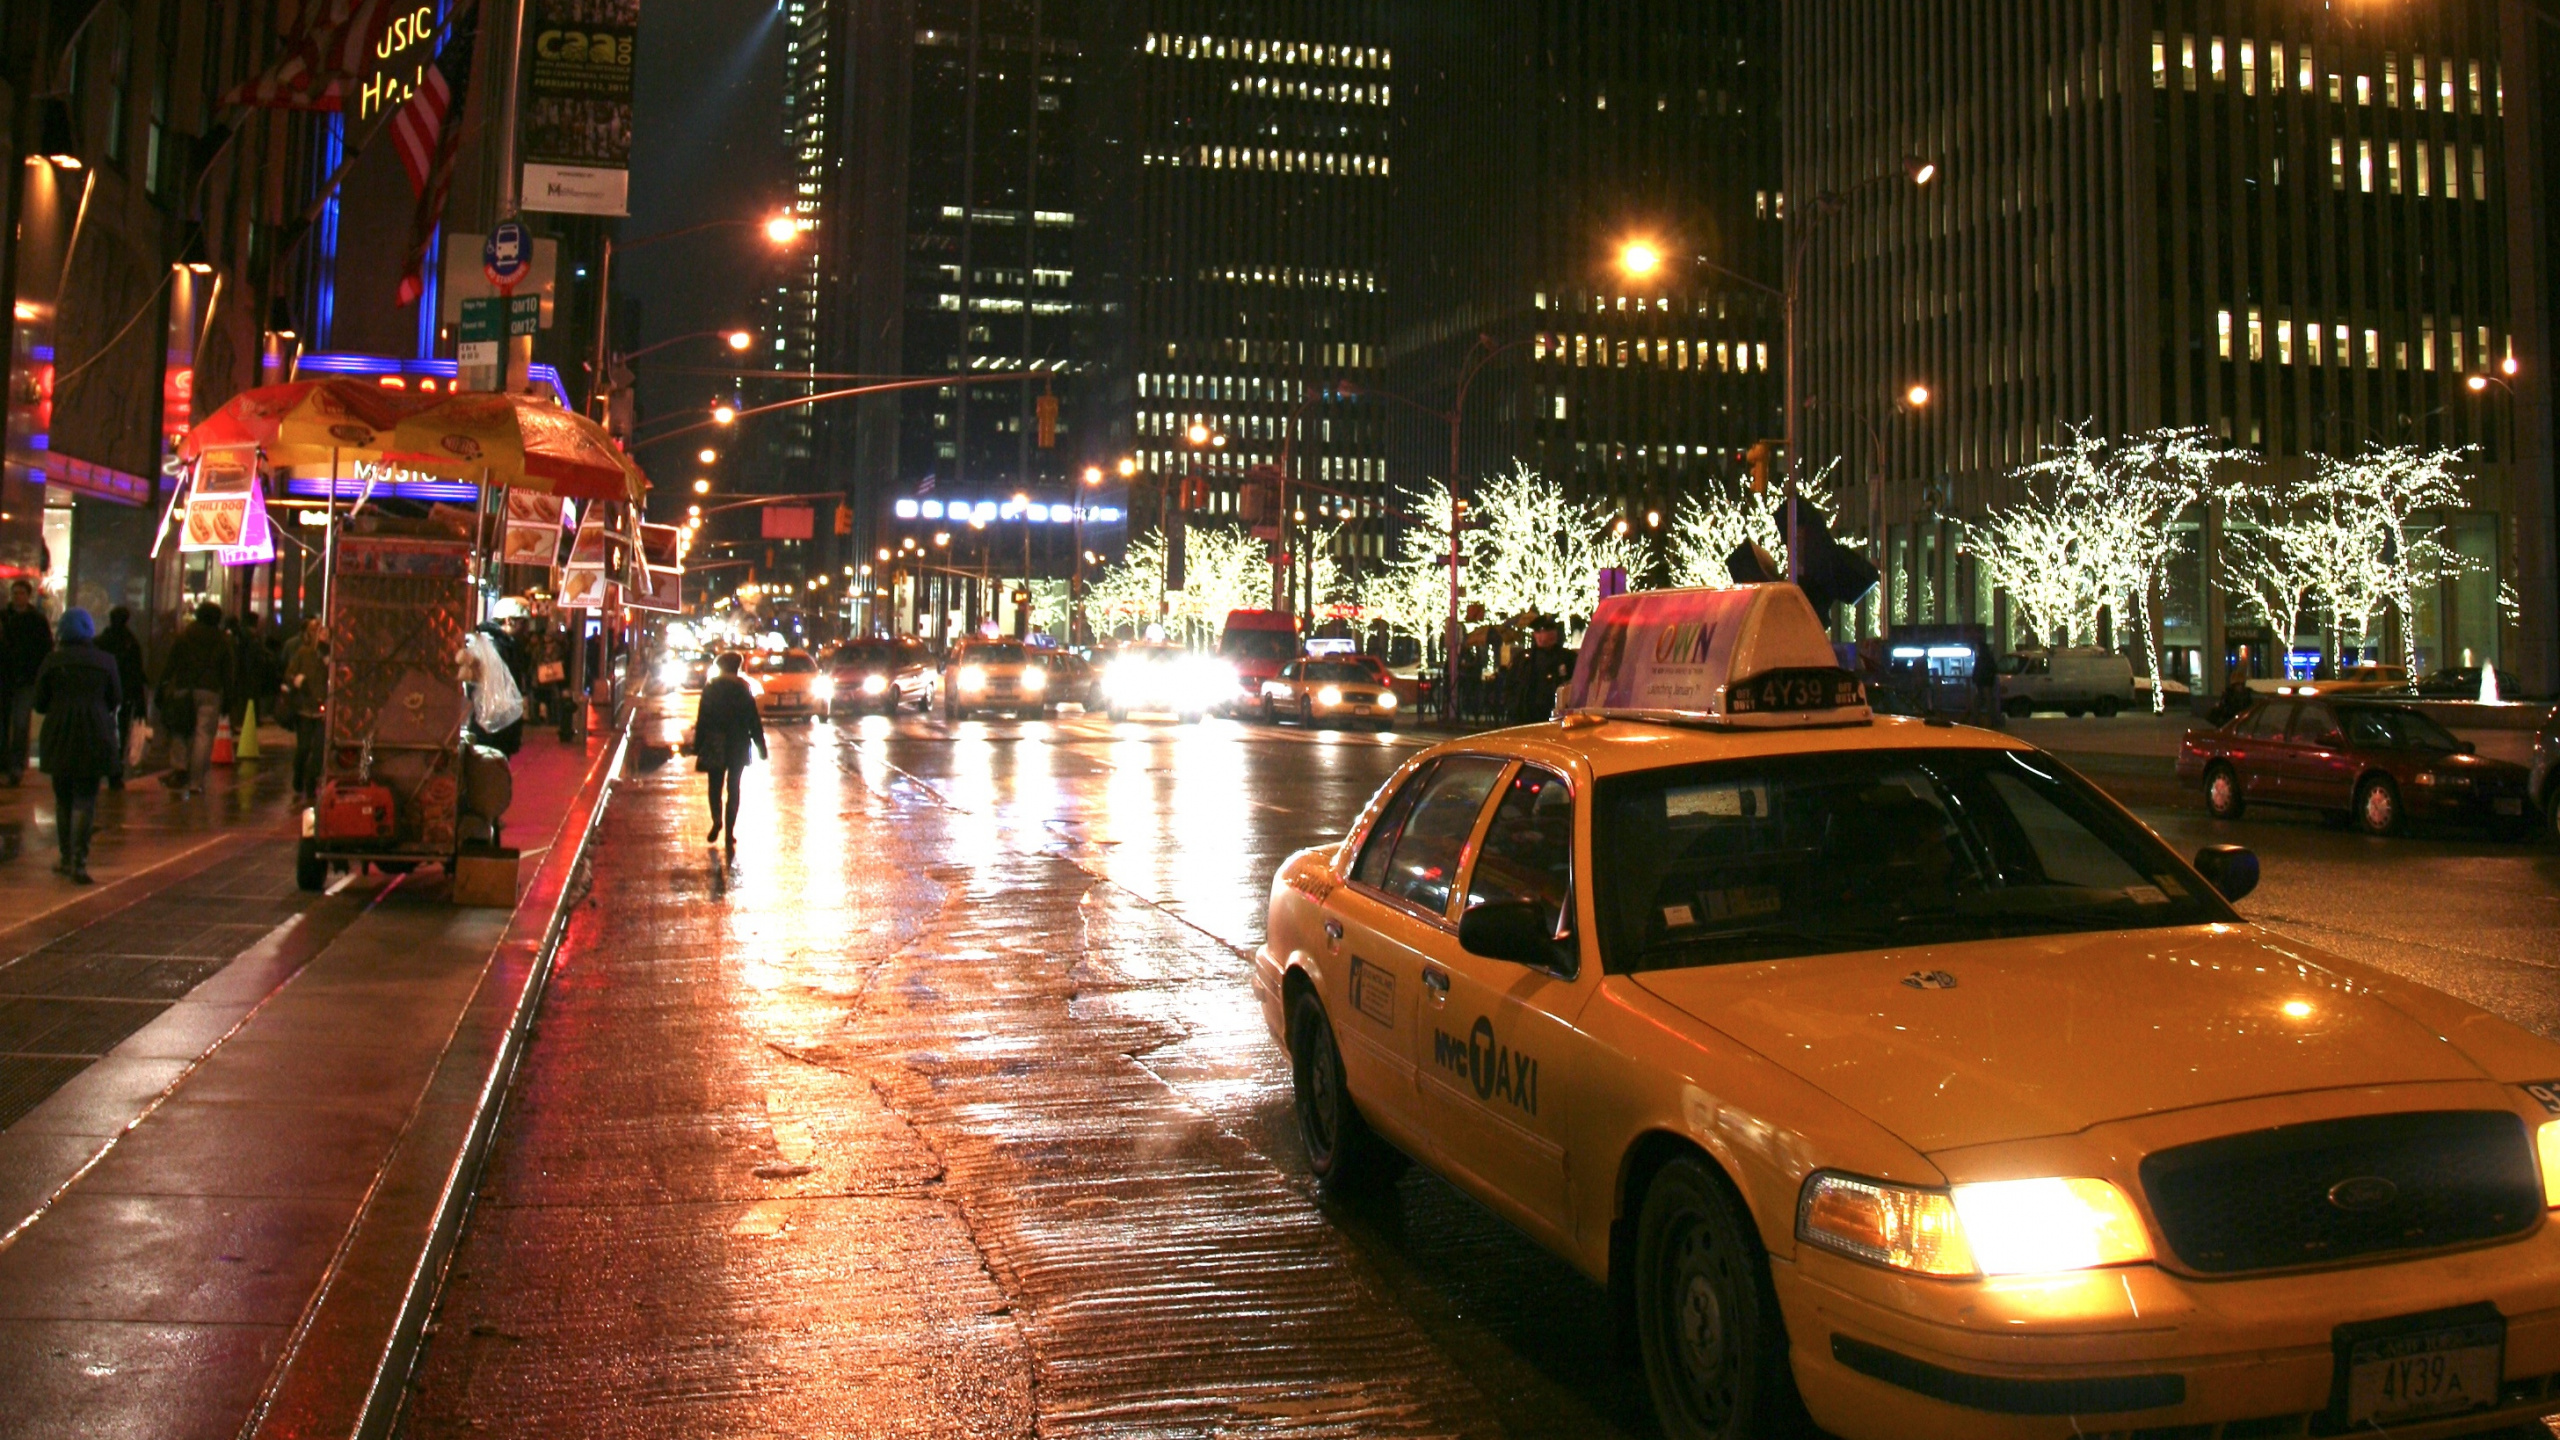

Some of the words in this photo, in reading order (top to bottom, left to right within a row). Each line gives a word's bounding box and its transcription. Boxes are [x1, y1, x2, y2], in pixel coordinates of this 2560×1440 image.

[376, 6, 432, 59] USIC
[537, 30, 617, 65] caa
[617, 35, 632, 66] 100
[534, 77, 581, 88] FEBRUARY
[511, 297, 537, 313] QM10
[511, 318, 536, 334] QM12
[192, 501, 219, 512] CHILI
[221, 501, 243, 511] DOG
[1655, 621, 1718, 664] OWN
[2228, 629, 2258, 639] CHASE
[1762, 678, 1822, 706] 4Y39
[1434, 1027, 1469, 1079] NYC
[1470, 1018, 1538, 1117] TAXI
